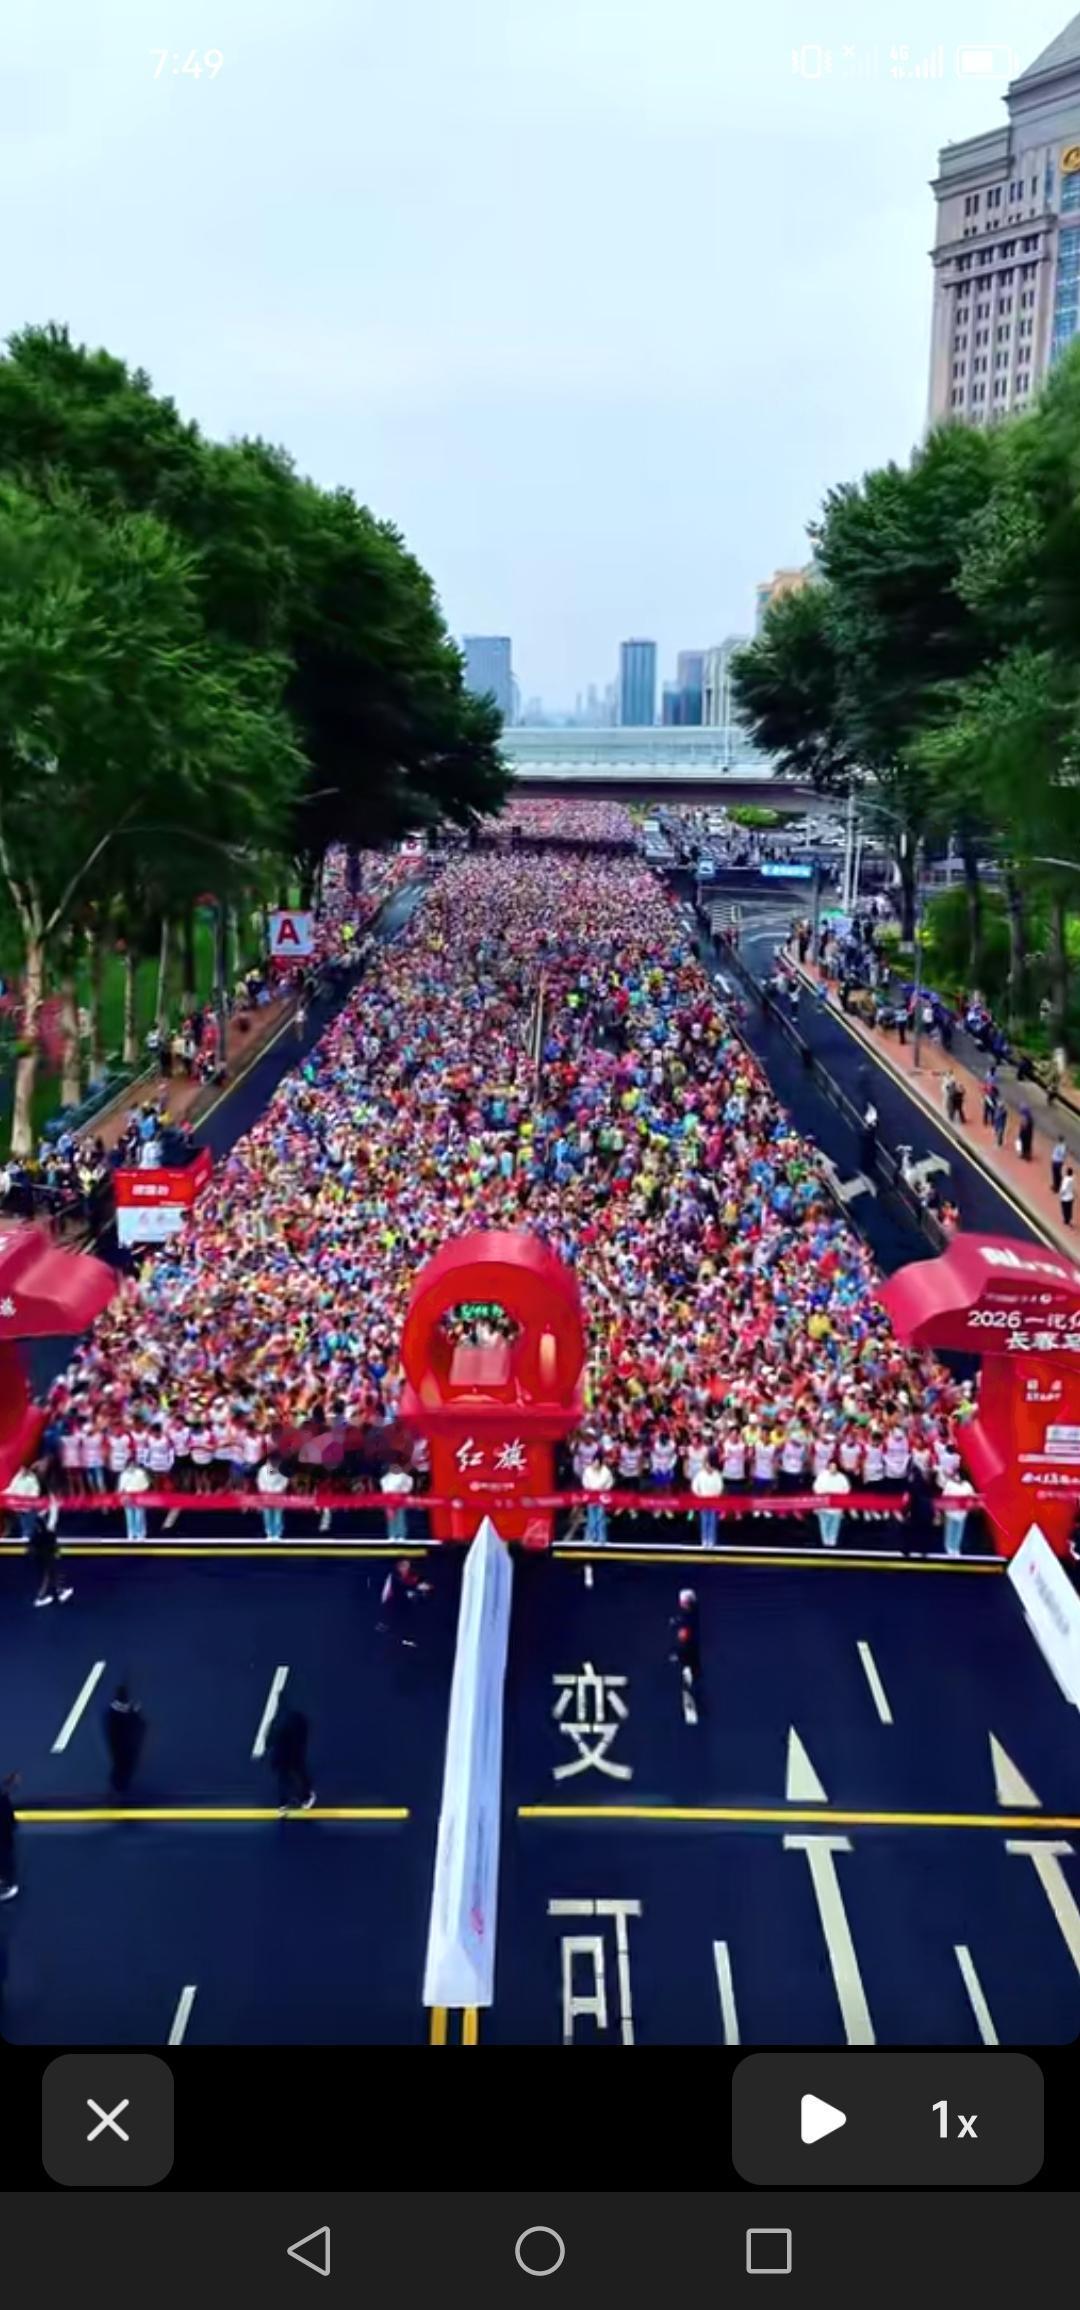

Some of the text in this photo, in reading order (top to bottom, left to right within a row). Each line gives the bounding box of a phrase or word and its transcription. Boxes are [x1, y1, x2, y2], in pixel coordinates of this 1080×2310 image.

[277, 919, 300, 945] A
[456, 1437, 528, 1473] 红旗
[551, 1661, 632, 1780] 变
[547, 1899, 641, 2045] 可
